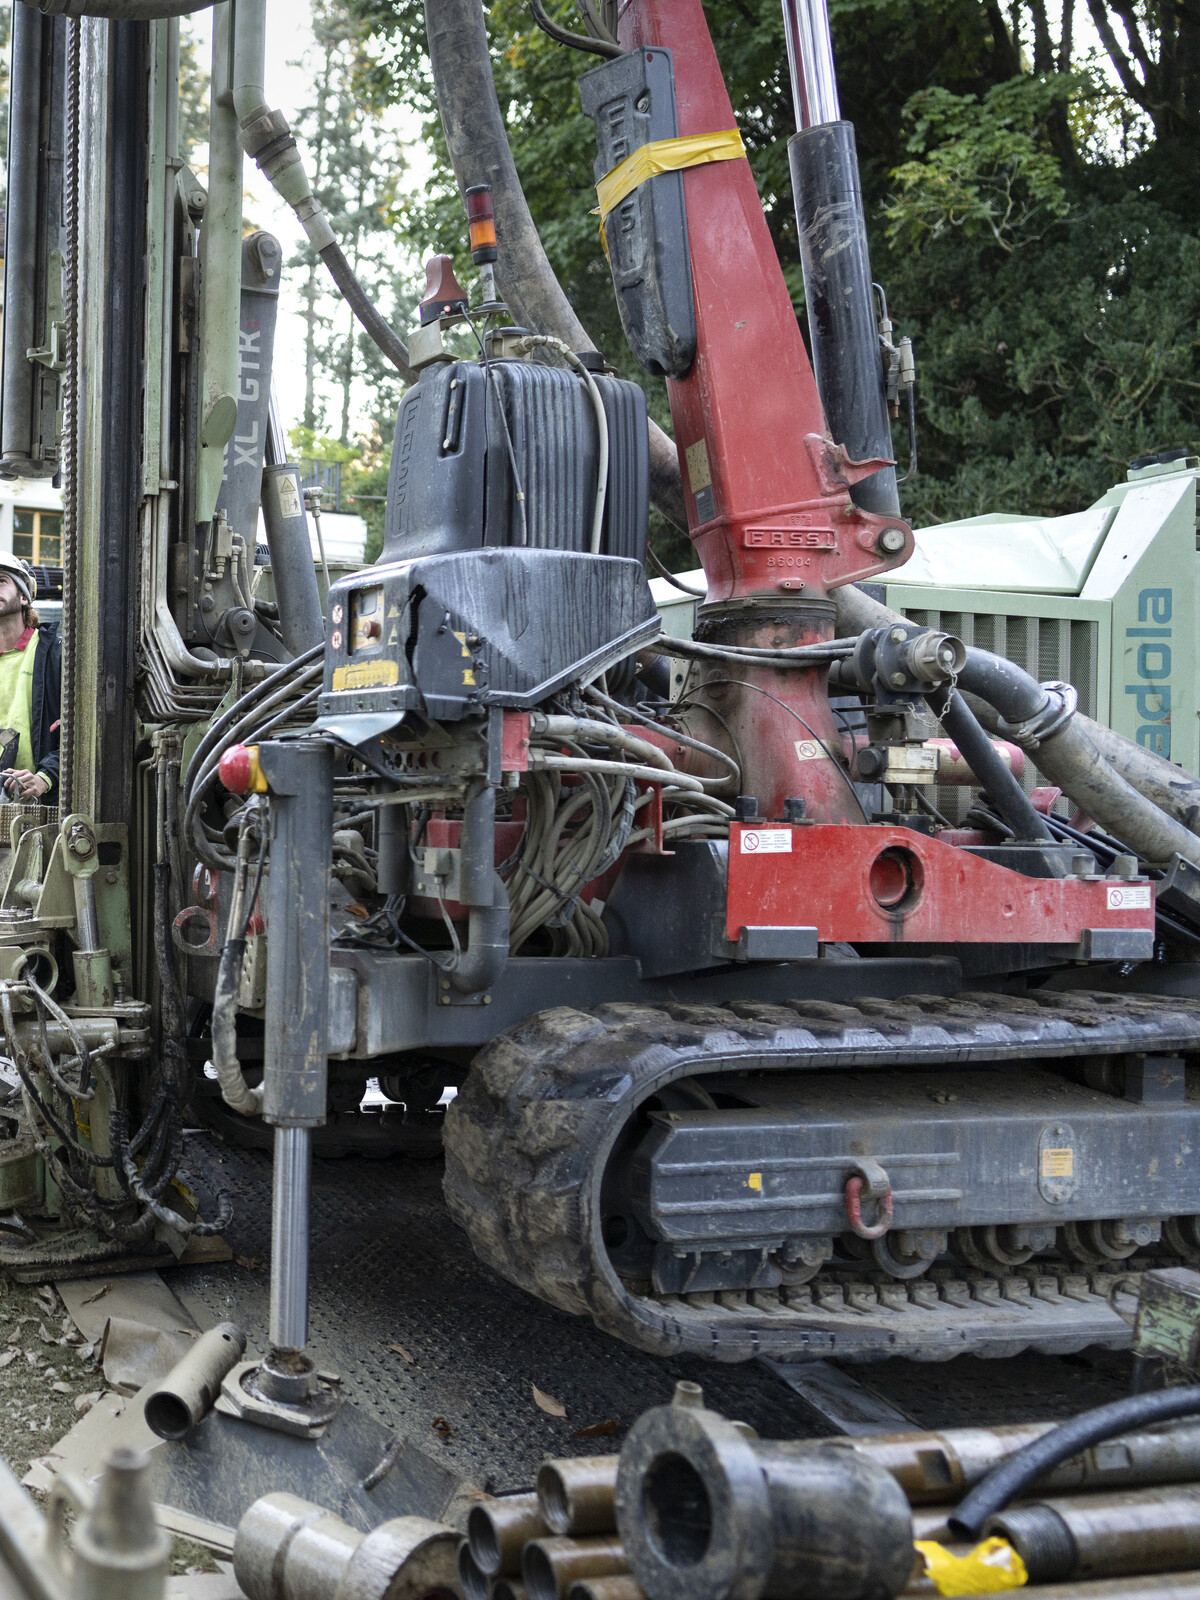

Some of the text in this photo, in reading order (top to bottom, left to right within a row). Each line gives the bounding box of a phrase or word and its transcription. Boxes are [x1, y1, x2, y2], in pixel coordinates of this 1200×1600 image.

[237, 330, 261, 402] GTK
[234, 421, 259, 467] XL
[751, 532, 832, 546] FASSI
[767, 557, 811, 567] 86004
